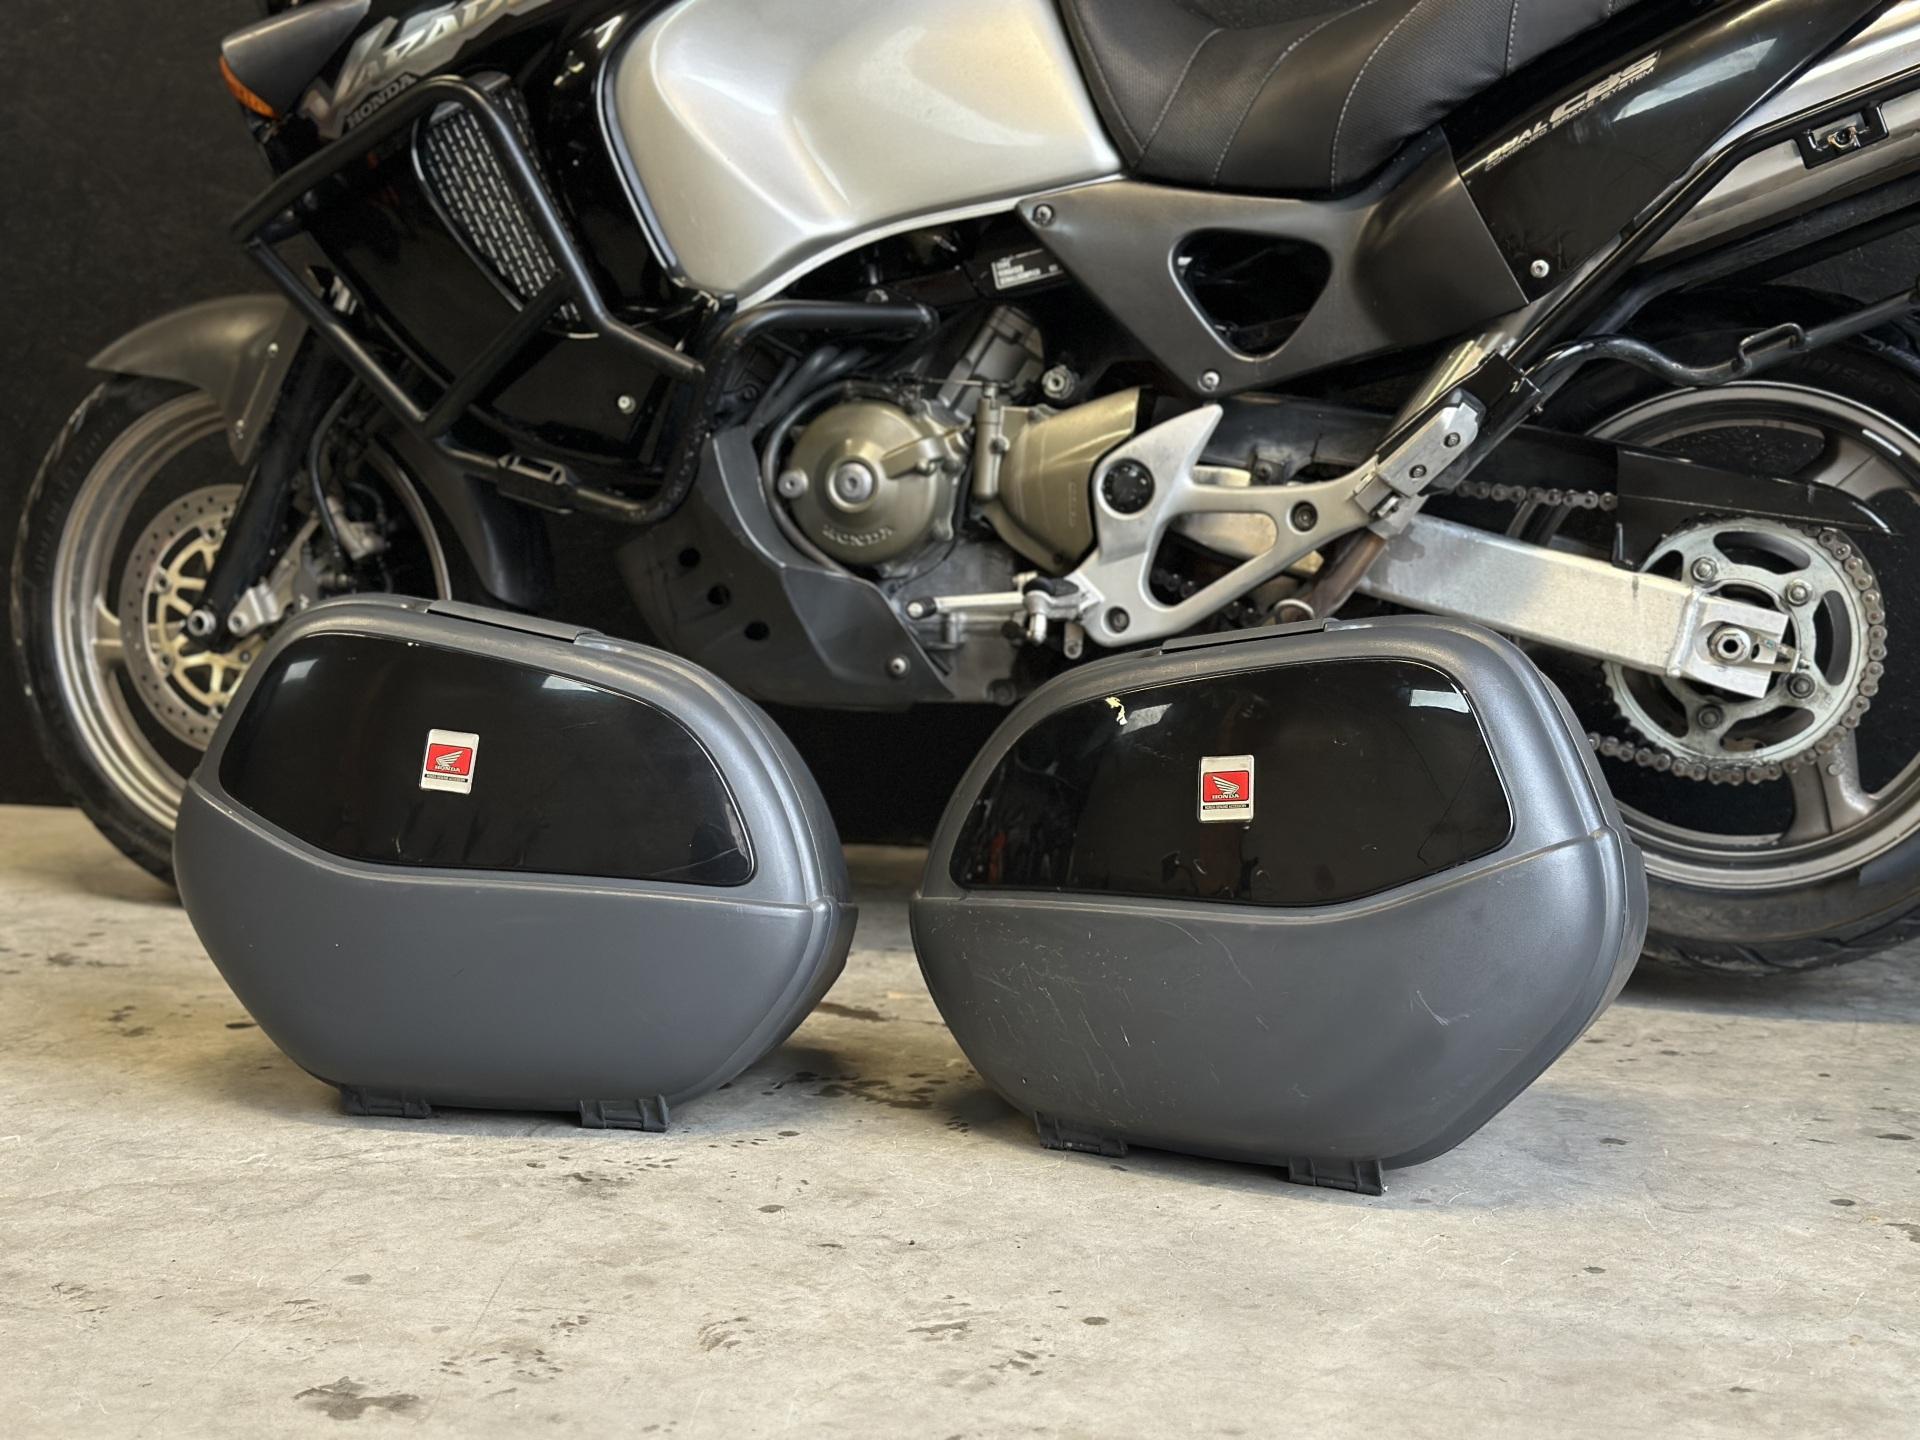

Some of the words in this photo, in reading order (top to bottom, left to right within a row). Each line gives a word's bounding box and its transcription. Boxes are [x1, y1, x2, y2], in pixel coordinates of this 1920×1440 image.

[346, 72, 419, 127] HONDA
[1549, 51, 1659, 123] CBS
[822, 525, 895, 547] HONDA
[434, 764, 462, 773] HONDA
